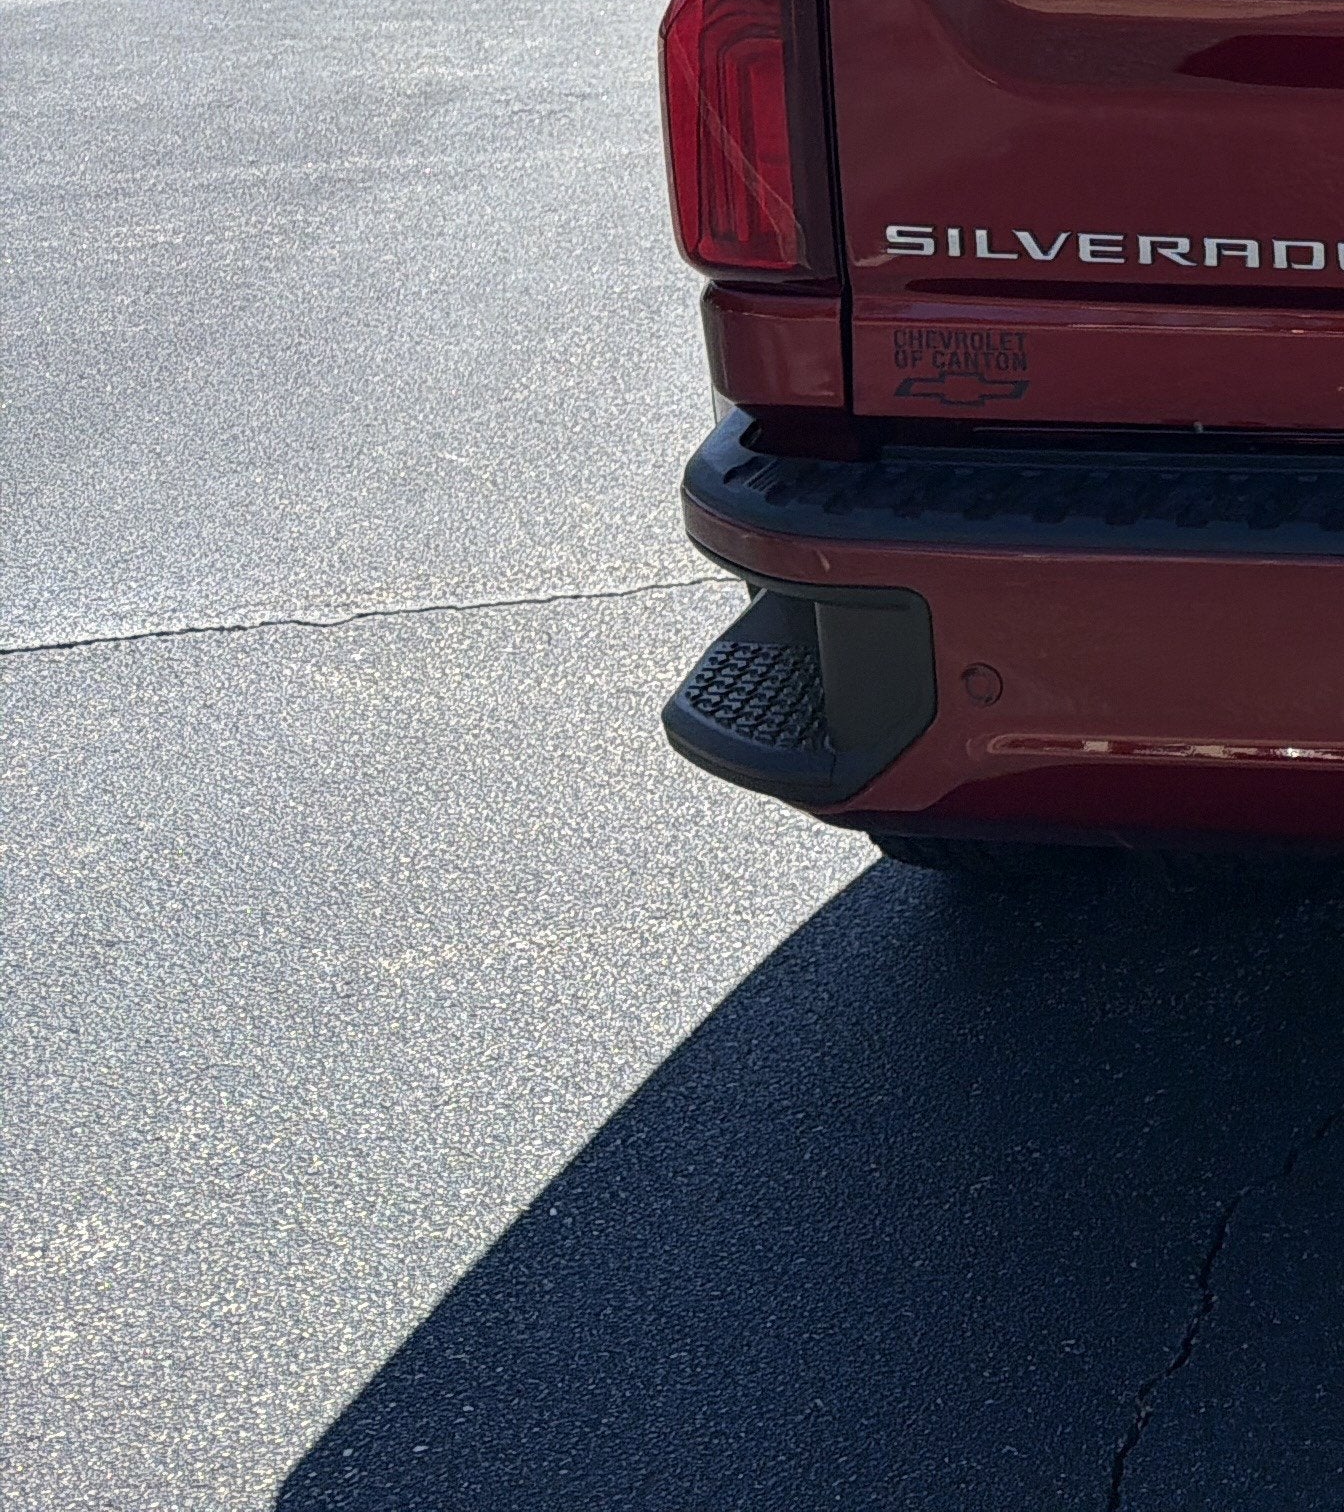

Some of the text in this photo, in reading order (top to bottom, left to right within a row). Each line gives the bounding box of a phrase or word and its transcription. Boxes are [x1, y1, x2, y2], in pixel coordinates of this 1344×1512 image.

[894, 330, 1028, 351] CHEVROLET
[894, 350, 1028, 371] OF CANTON
